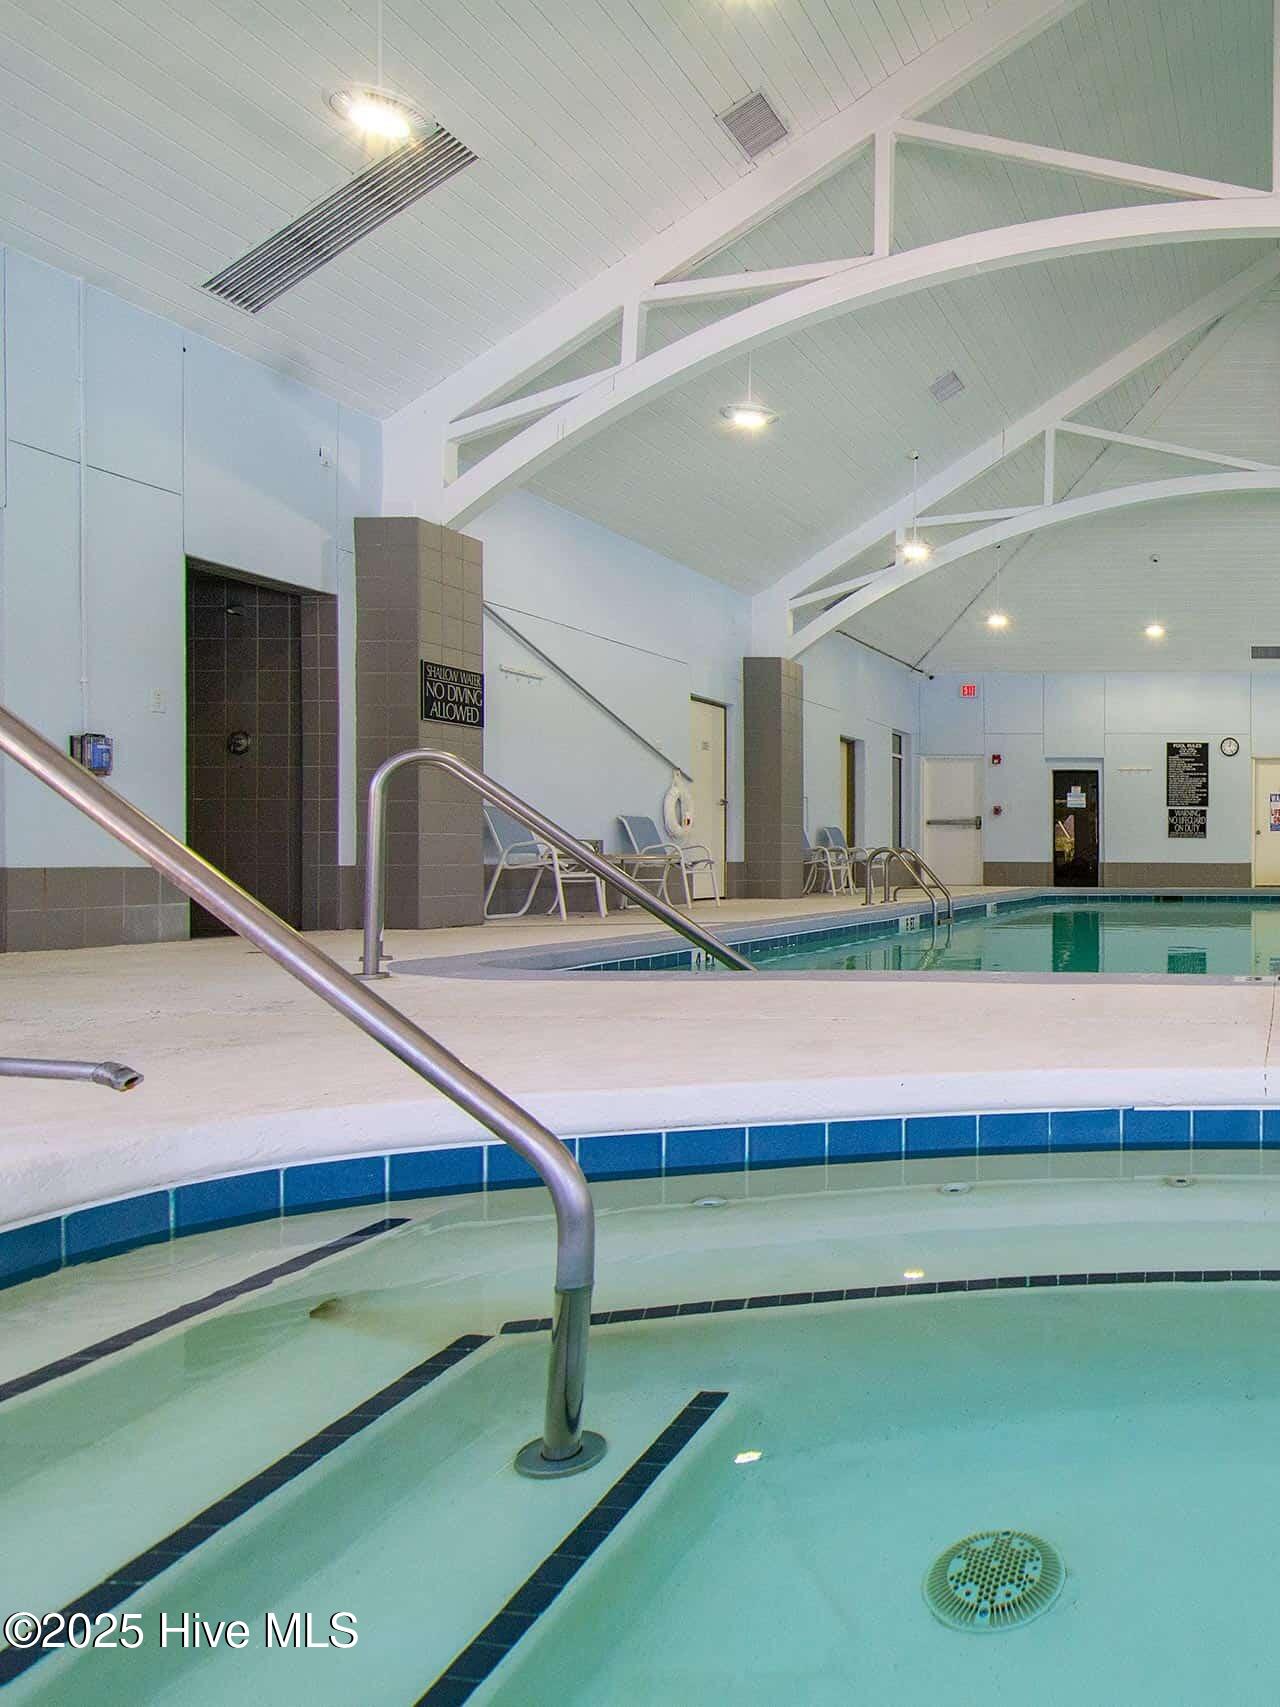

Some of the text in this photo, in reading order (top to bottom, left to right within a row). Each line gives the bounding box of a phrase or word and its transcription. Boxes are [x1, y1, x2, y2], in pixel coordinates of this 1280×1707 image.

[426, 664, 480, 687] SHALLOW WATER
[426, 681, 482, 706] NO DIVING
[430, 701, 480, 723] ALLOWED
[1168, 816, 1207, 825] NO LIFEGUARD
[1273, 816, 1280, 824] ON
[1174, 824, 1200, 832] ON DUTY
